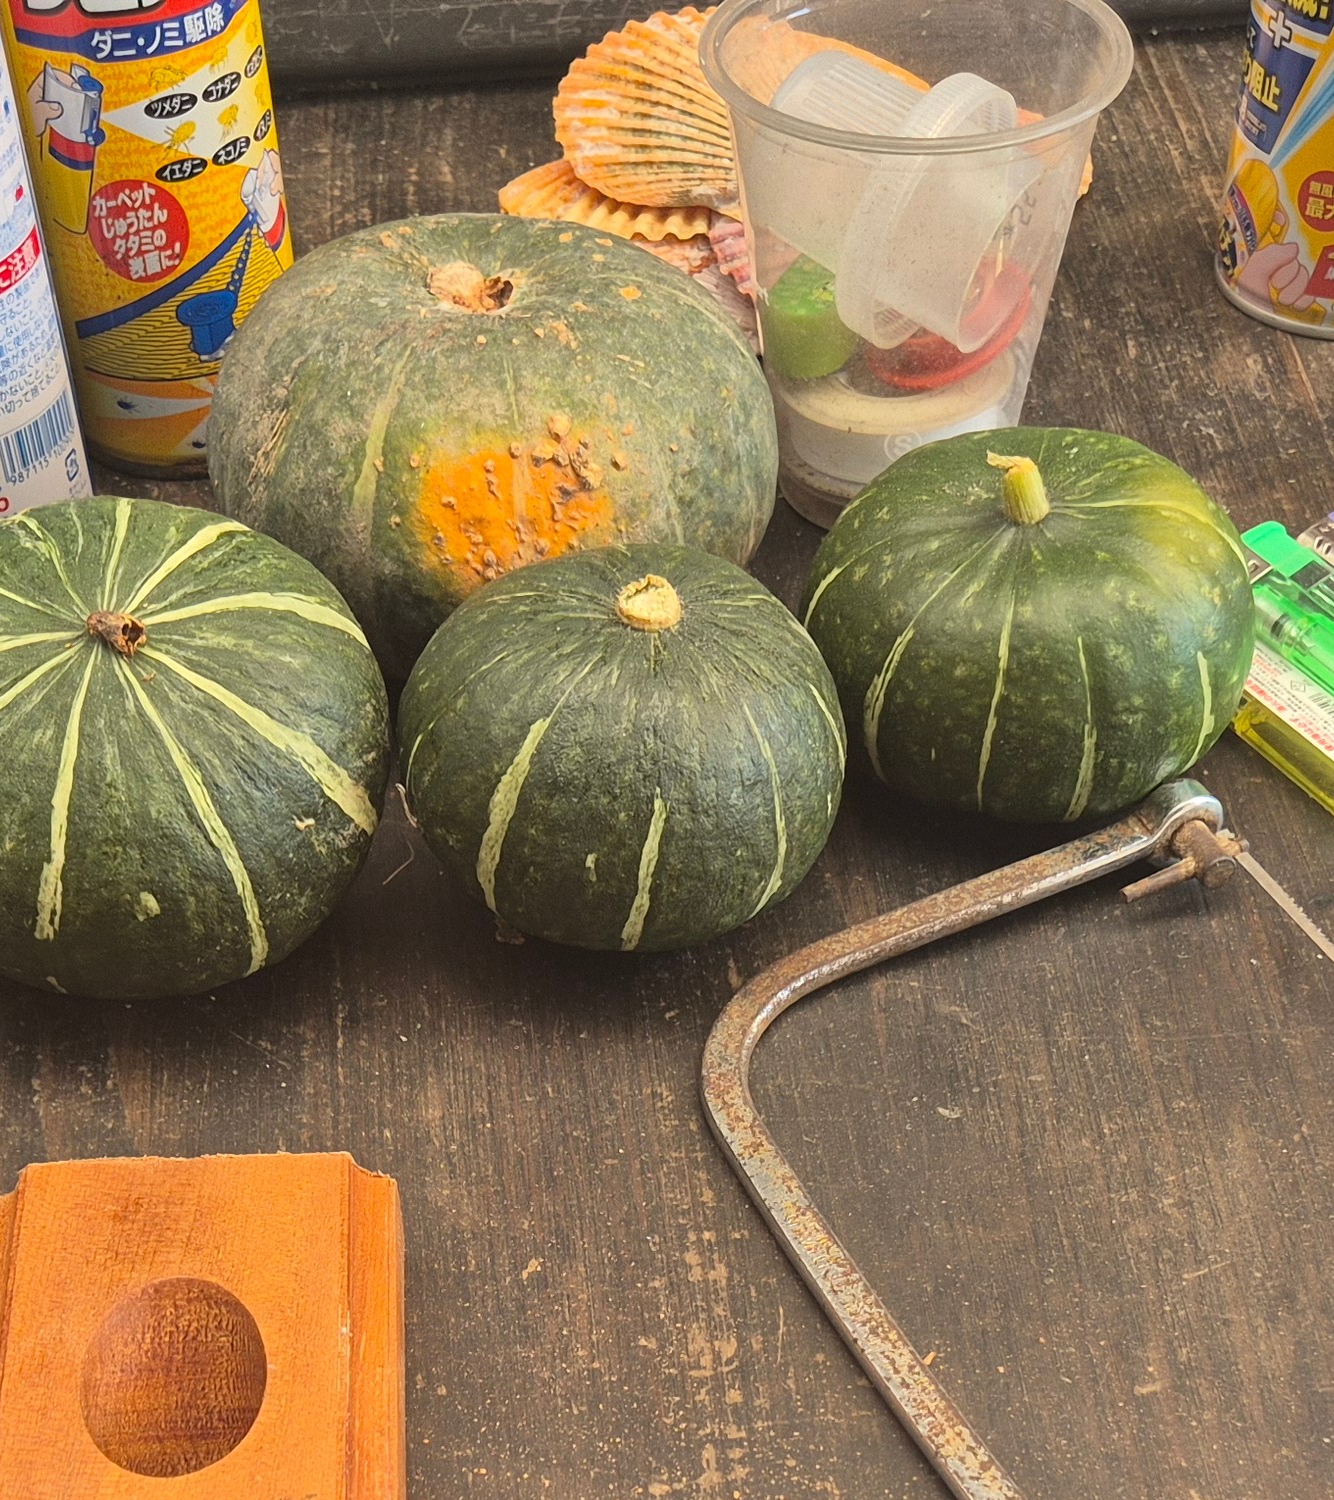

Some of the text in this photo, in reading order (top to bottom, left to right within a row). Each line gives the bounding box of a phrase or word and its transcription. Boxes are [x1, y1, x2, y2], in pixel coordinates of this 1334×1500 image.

[91, 4, 225, 59] ダニ・ノミ駆除
[207, 73, 240, 100] コナダニ
[1240, 48, 1280, 112] り阻止
[149, 95, 192, 118] ツメダニ
[217, 138, 249, 165] ネコノミ
[163, 159, 205, 181] イエダニ
[92, 182, 155, 217] カーペット
[101, 203, 168, 239] じゅうたん
[114, 228, 166, 260] タタミの
